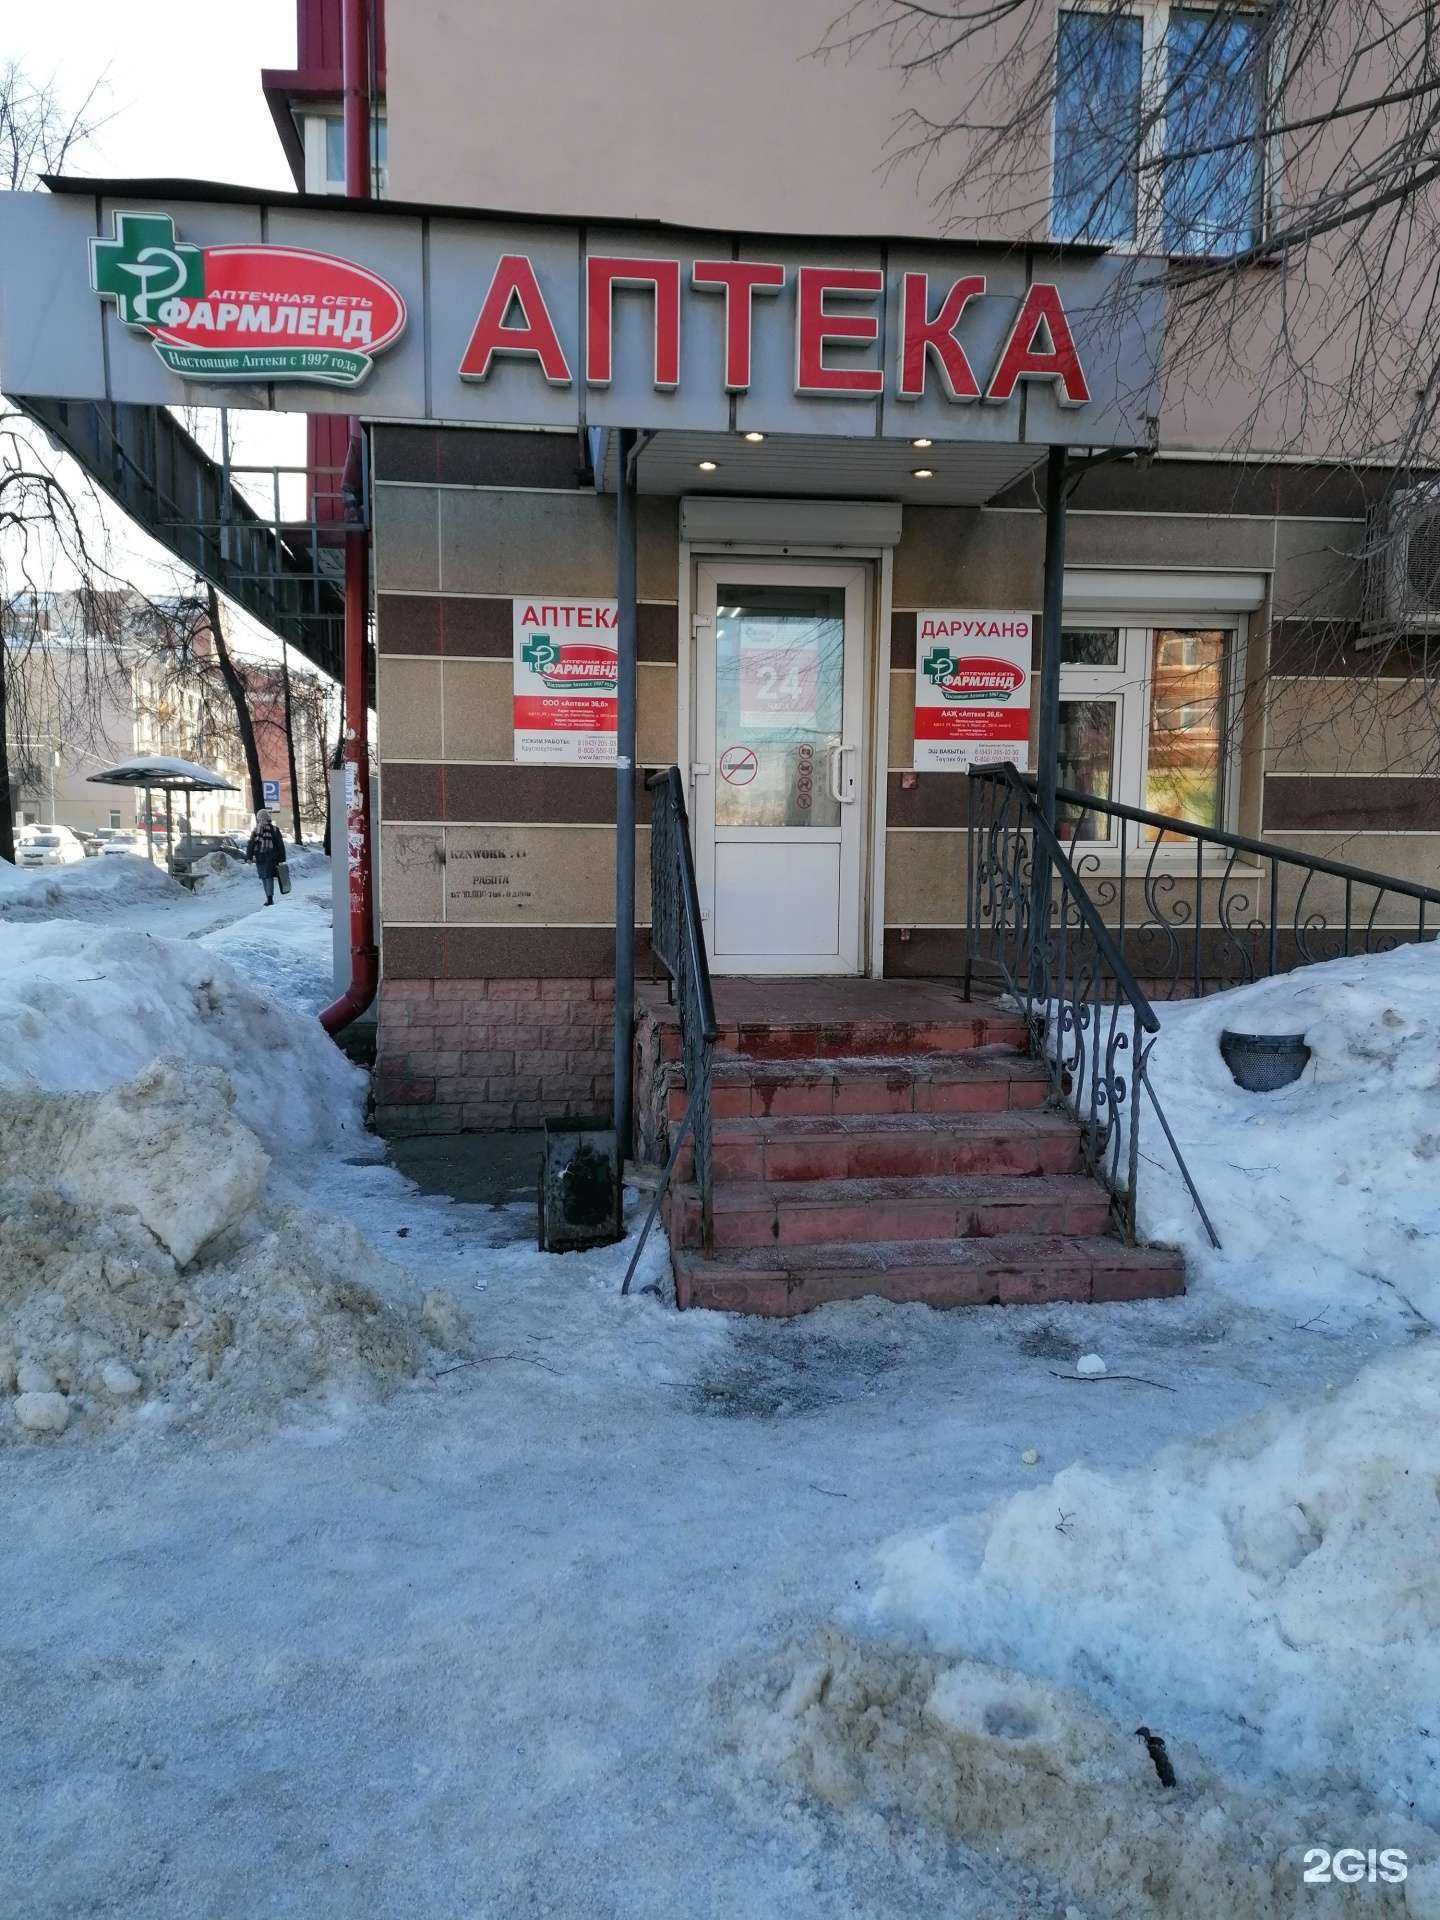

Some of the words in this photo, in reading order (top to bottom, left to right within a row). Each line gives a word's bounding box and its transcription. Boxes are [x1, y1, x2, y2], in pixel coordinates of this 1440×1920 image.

[208, 288, 316, 304] АПТЕЧНАЯ
[321, 294, 374, 308] СЕТЬ
[157, 297, 374, 345] ФАРМЛЕНД
[458, 254, 1091, 408] АПТЕКА
[168, 352, 239, 369] Настоящие
[241, 354, 287, 368] Аптеки
[290, 356, 297, 367] с
[301, 353, 329, 368] 1997
[330, 355, 357, 373] года
[921, 620, 1029, 639] ДАРУХАНӘ
[755, 665, 801, 699] 24
[942, 675, 1015, 689] ФАРМЛЕНД
